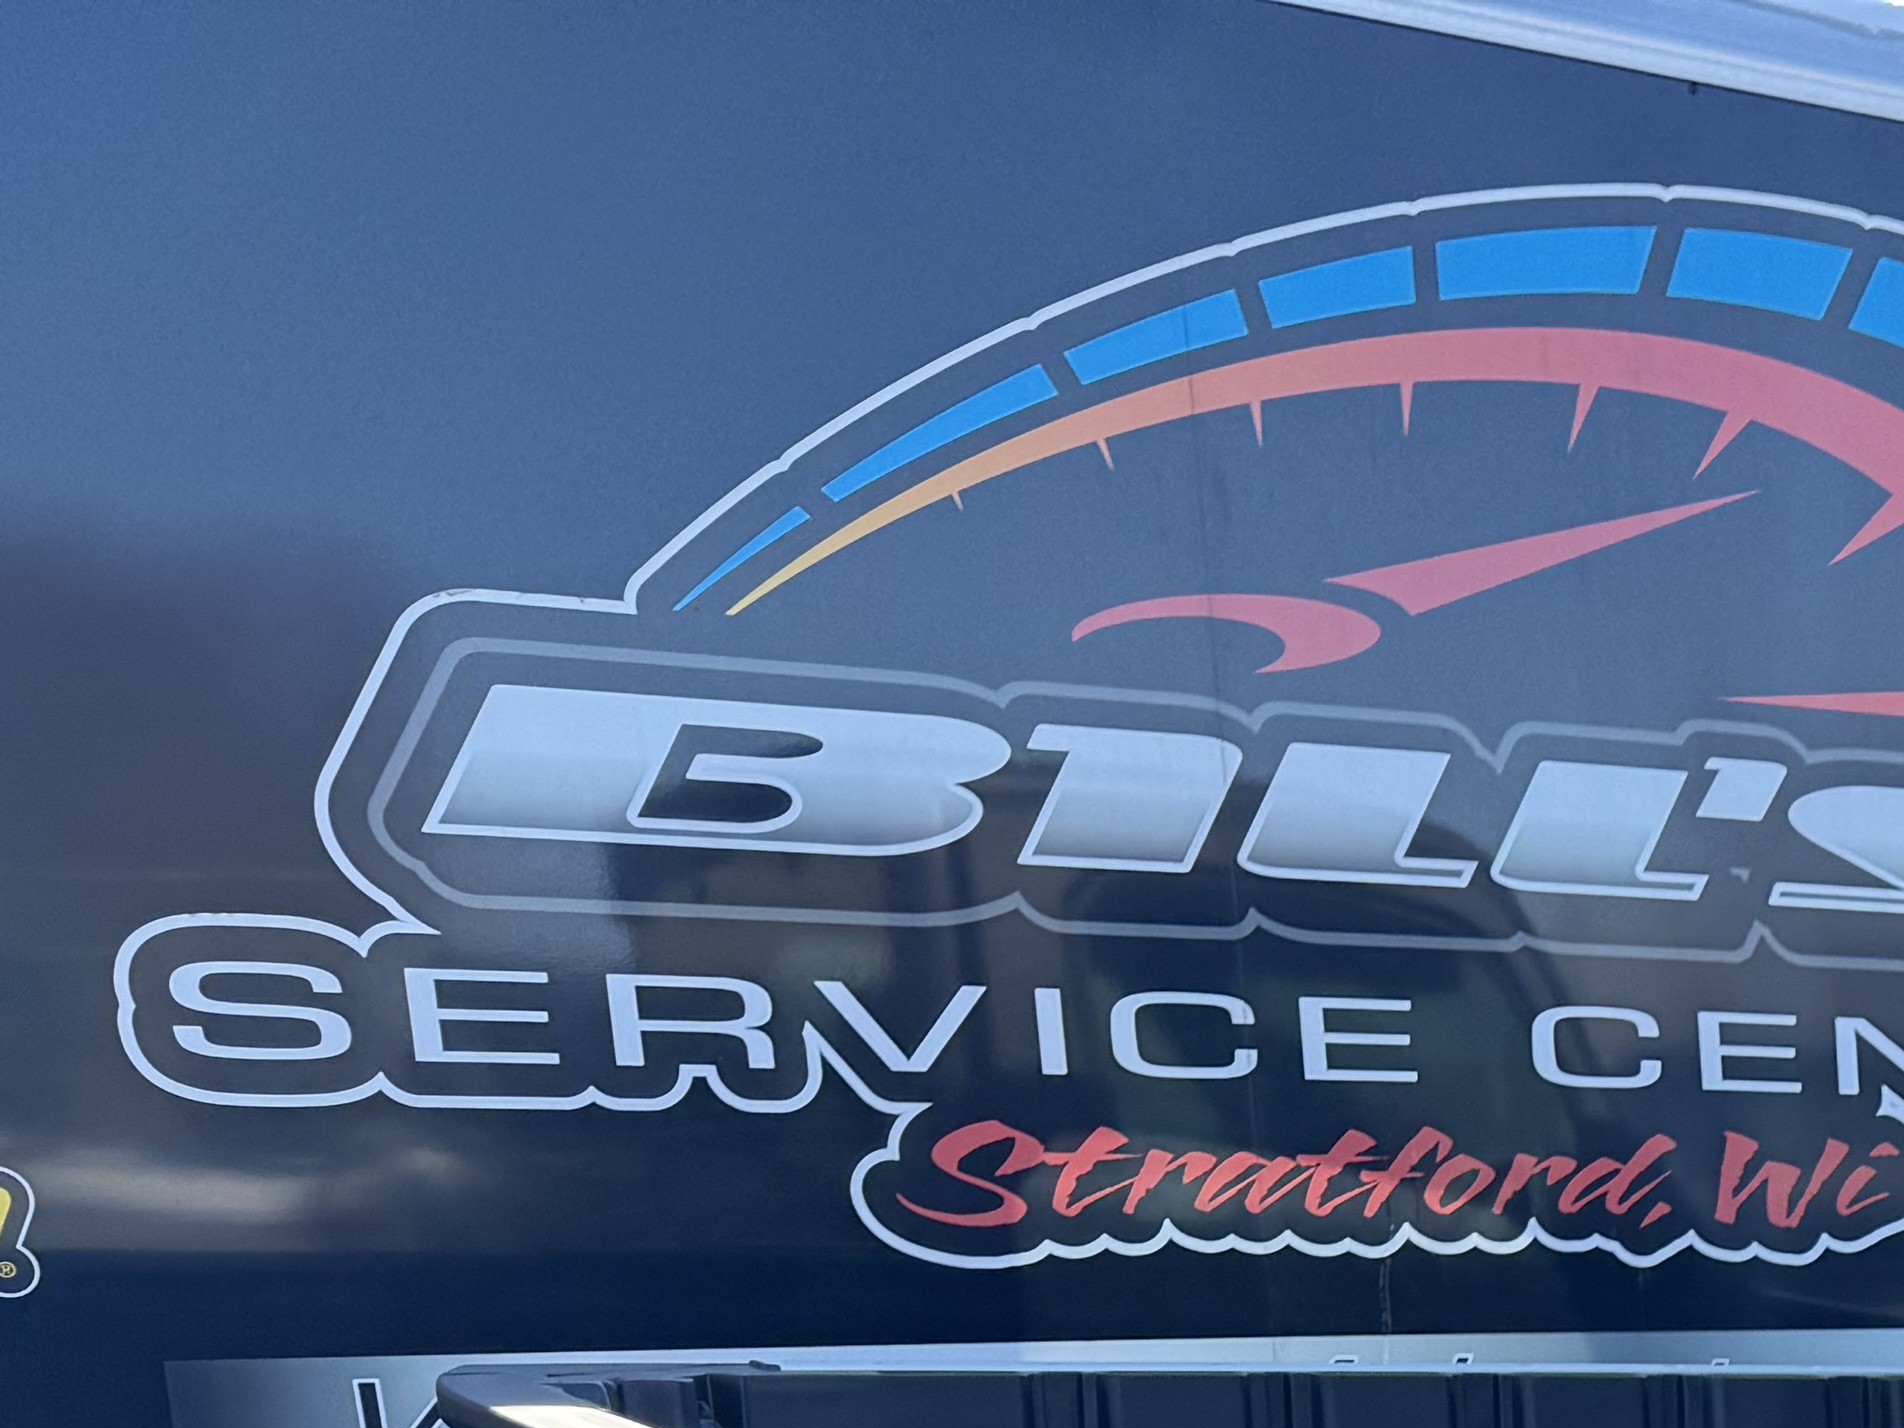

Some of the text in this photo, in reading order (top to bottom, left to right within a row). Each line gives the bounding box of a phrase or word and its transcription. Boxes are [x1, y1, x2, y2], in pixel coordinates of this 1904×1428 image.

[166, 960, 1419, 1084] SERVICE
[895, 1117, 1901, 1230] Stratford, Wi
